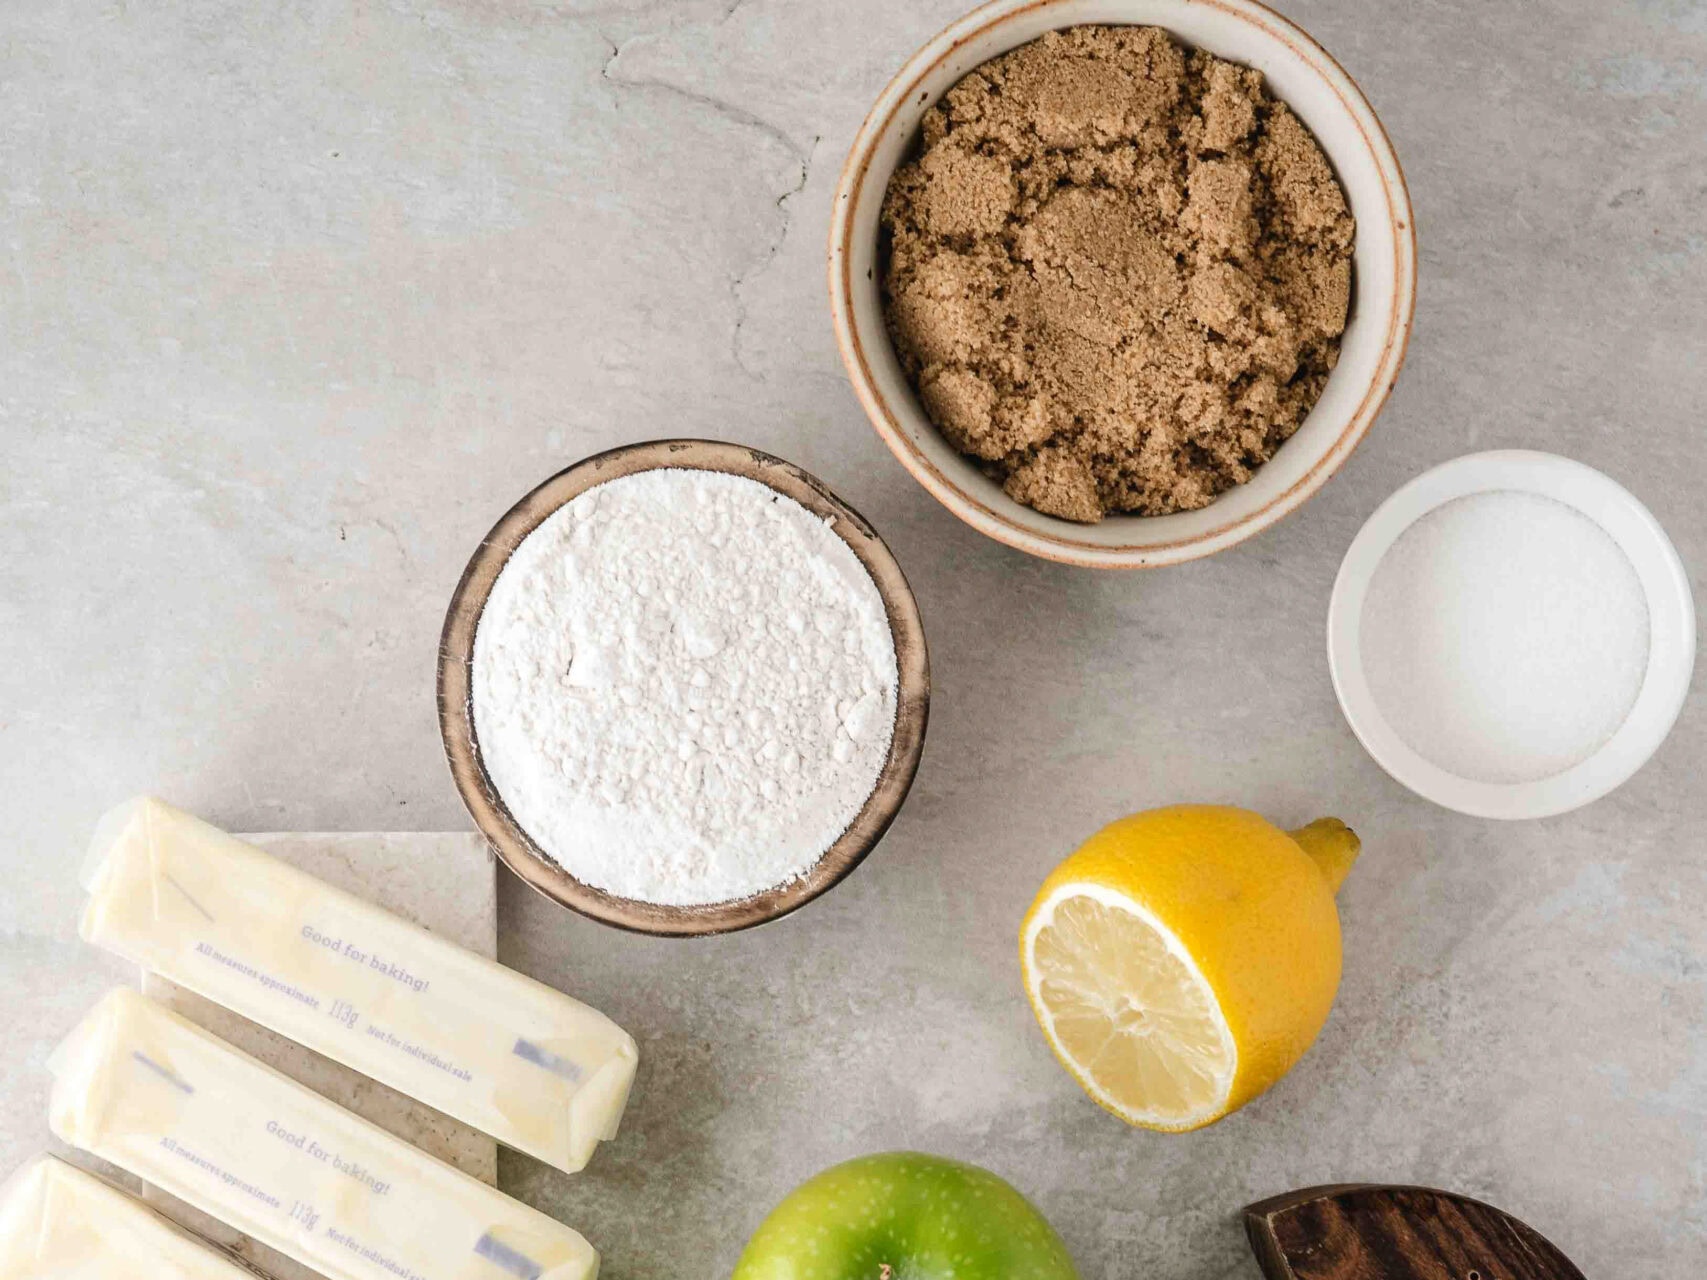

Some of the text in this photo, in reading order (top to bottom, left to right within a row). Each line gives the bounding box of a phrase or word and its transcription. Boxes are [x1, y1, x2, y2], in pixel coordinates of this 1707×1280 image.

[195, 942, 319, 1009] All measures approximate
[302, 925, 430, 993] Good for baking!
[328, 999, 359, 1029] 113g
[367, 1025, 472, 1083] Not for individual sale
[159, 1137, 280, 1209] All measures approximate
[266, 1120, 390, 1195] Good for baking!
[289, 1200, 320, 1232] 113g
[326, 1227, 344, 1244] Not
[345, 1236, 360, 1251] for
[360, 1243, 411, 1280] individual
